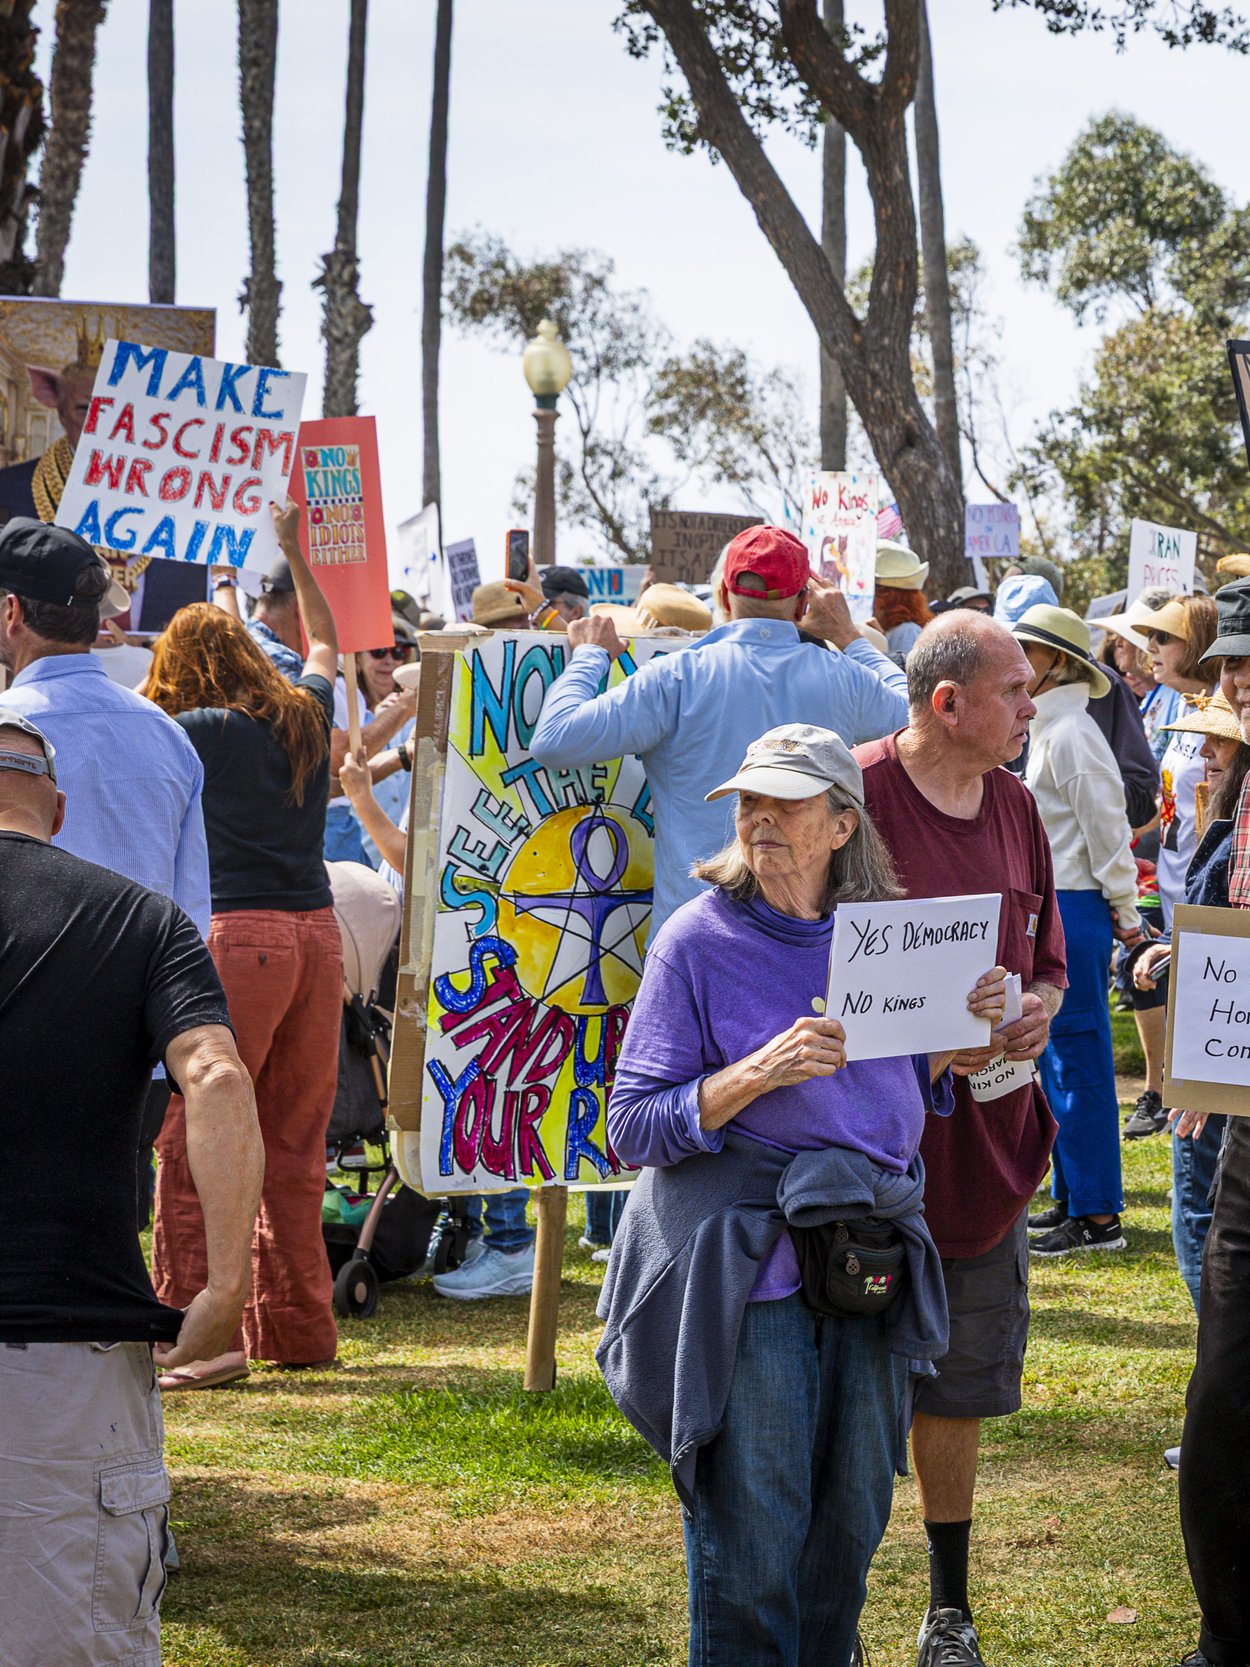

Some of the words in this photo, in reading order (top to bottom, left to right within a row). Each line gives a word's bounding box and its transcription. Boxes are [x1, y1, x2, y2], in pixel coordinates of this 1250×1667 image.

[107, 340, 292, 420] MAKE
[83, 396, 295, 477] FASCISM
[319, 447, 346, 468] NO
[82, 448, 263, 516] WRONG
[305, 468, 362, 498] KINGS
[325, 504, 350, 524] NO
[74, 498, 257, 569] AGAIN
[310, 523, 364, 547] IDIOTS
[1149, 528, 1181, 559] IRAN
[310, 545, 366, 566] EITHER
[848, 918, 893, 963] YES
[902, 920, 990, 952] DEMOCRACY
[1203, 956, 1237, 984] No
[841, 990, 873, 1017] NO
[970, 1057, 1007, 1078] ARCH
[994, 1066, 1016, 1084] NO
[426, 1056, 556, 1182] YOUR
